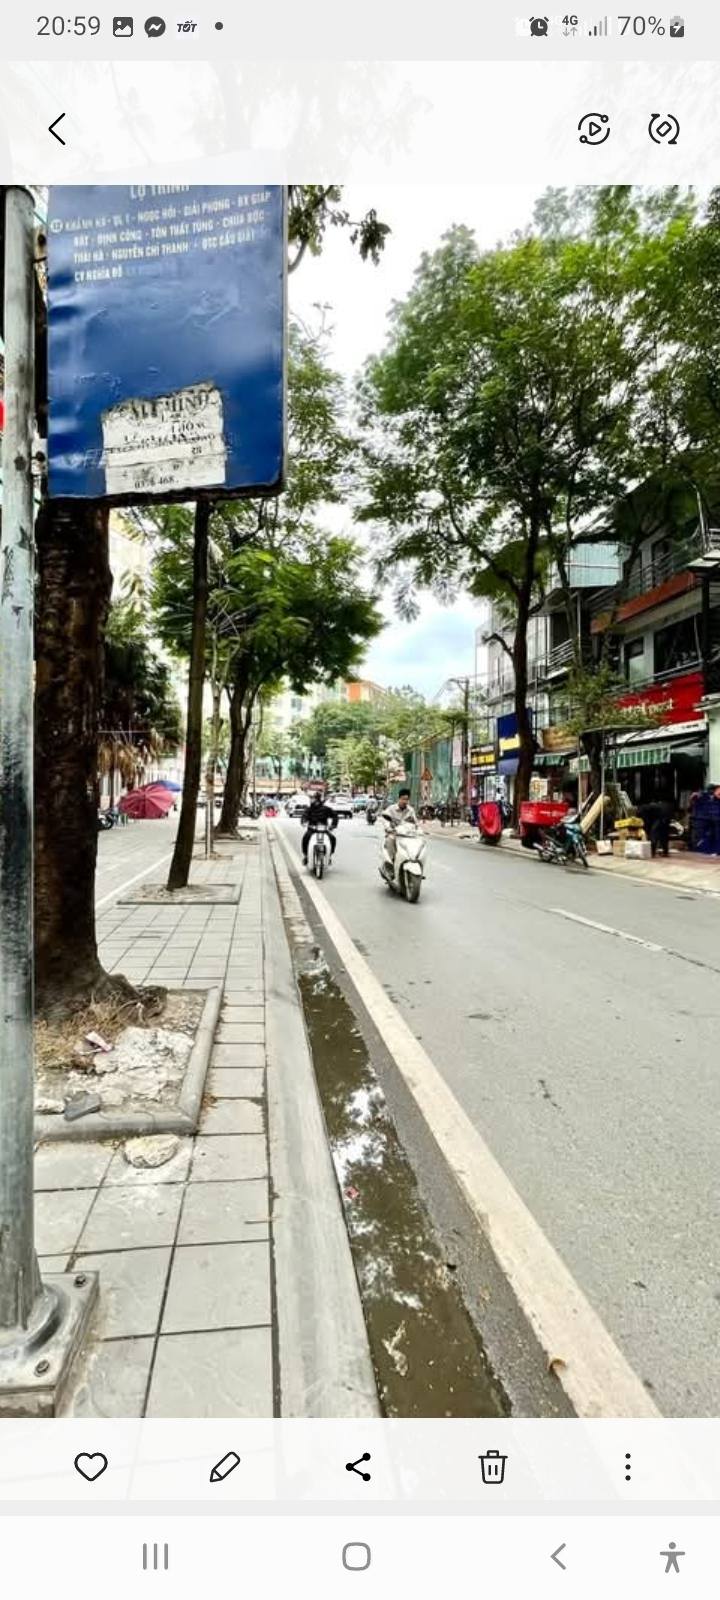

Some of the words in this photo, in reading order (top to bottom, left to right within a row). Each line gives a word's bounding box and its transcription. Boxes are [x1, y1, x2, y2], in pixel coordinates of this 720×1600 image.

[36, 15, 101, 36] 20:59
[562, 15, 579, 26] 4G
[617, 15, 666, 36] 70%
